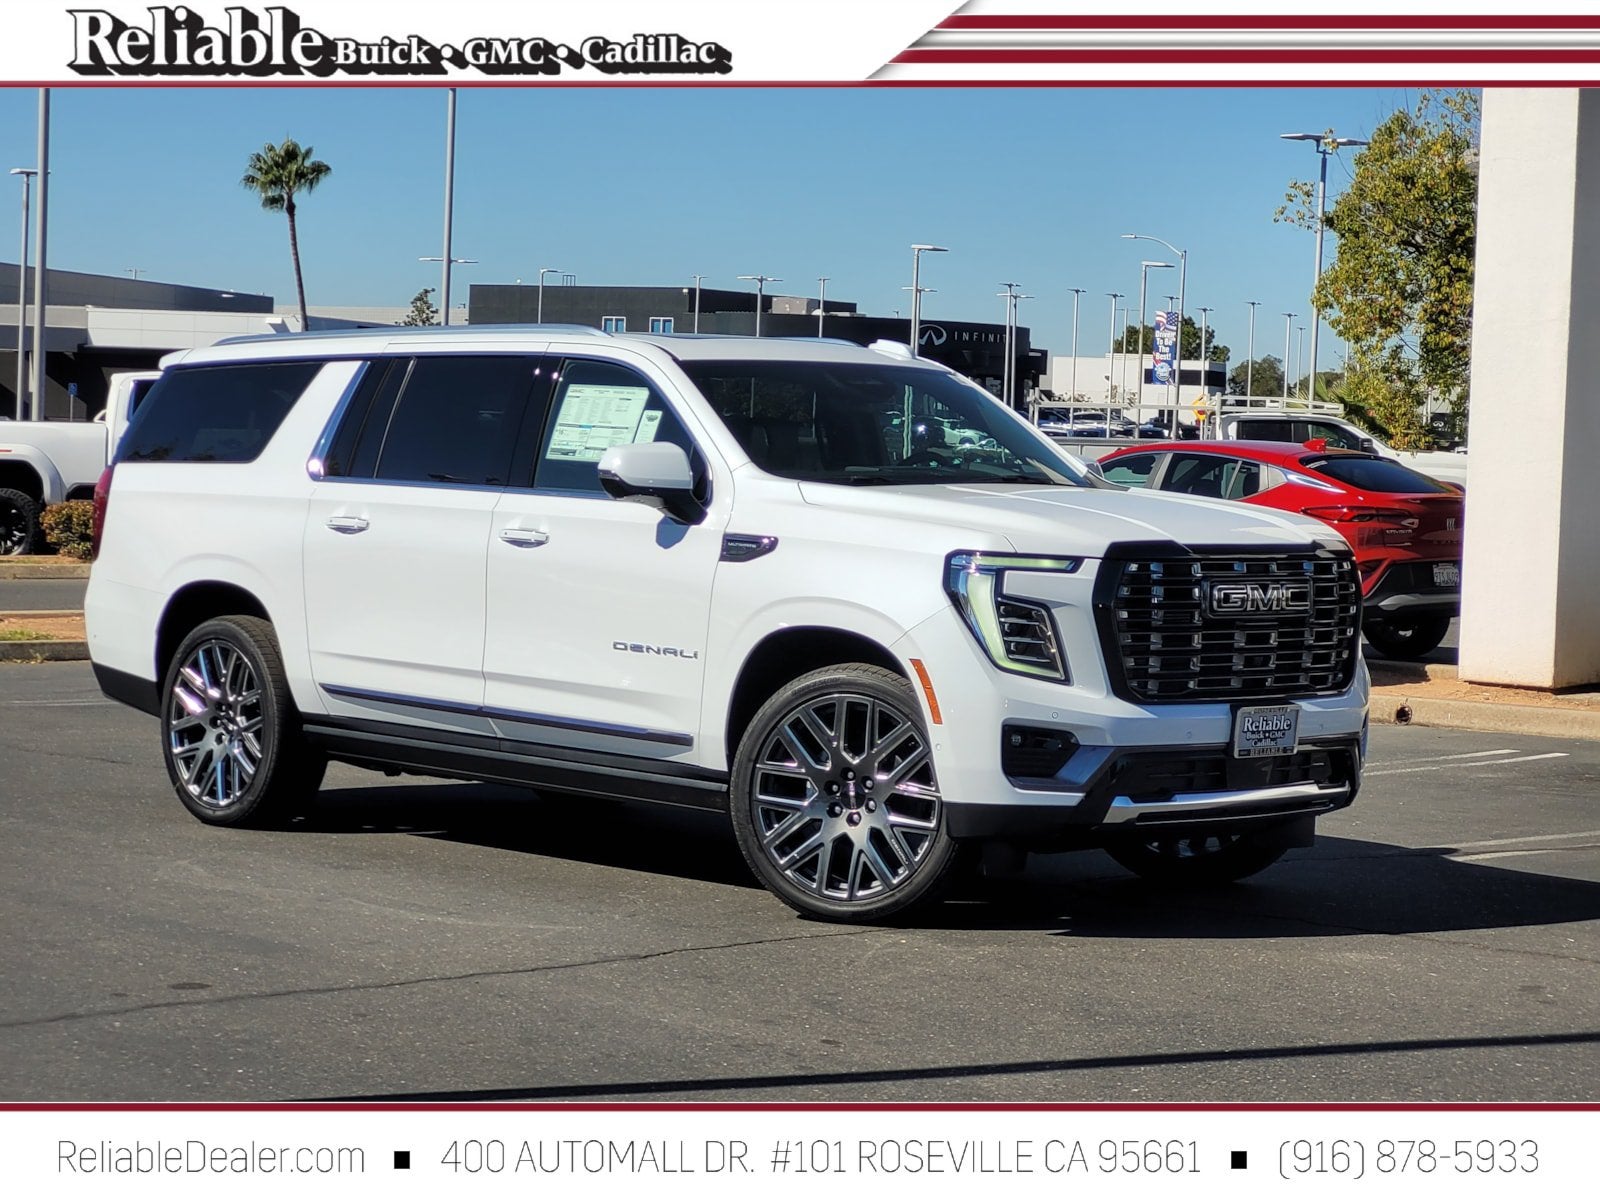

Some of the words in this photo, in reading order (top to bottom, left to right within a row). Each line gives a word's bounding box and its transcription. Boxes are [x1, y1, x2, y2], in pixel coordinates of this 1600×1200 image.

[1158, 345, 1170, 353] The
[1213, 584, 1311, 611] GMC
[613, 641, 698, 660] DENALI
[1243, 715, 1292, 732] Reliable
[1246, 731, 1265, 740] Buick
[1269, 731, 1286, 739] GMC
[1252, 739, 1278, 747] Cadillac
